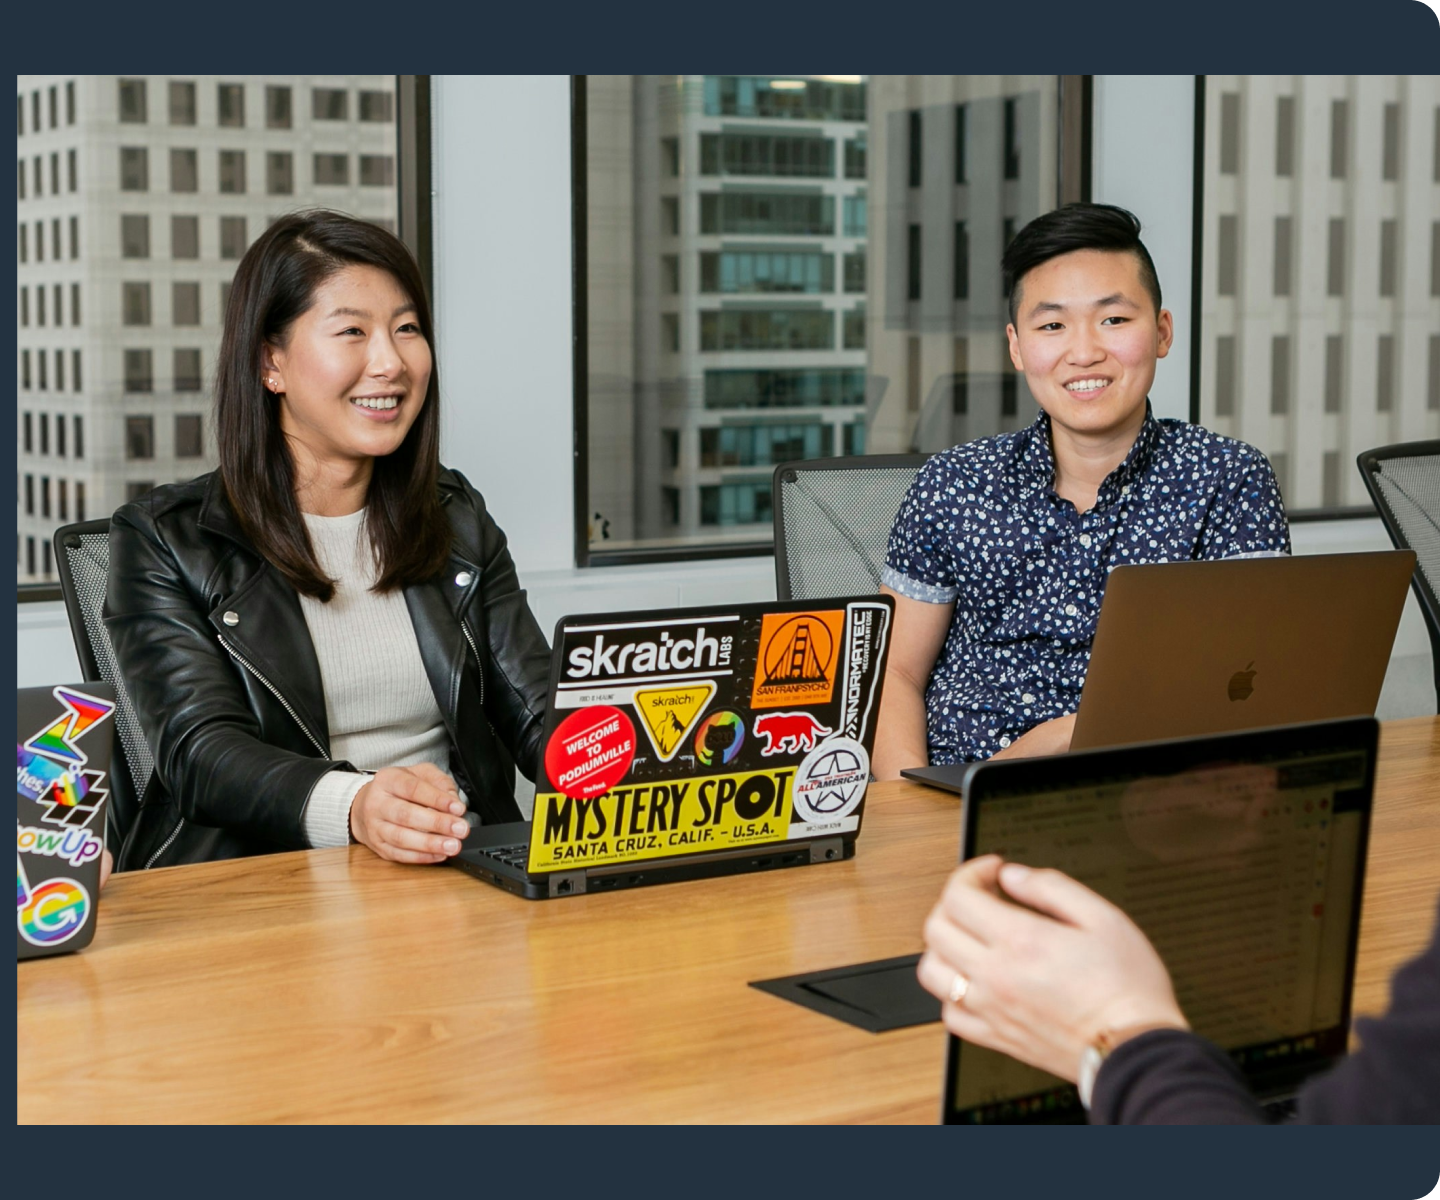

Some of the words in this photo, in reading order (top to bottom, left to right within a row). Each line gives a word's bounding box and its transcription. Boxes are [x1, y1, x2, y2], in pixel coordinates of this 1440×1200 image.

[567, 627, 719, 678] skratch
[718, 635, 733, 666] LABS
[847, 611, 866, 713] NORMATEC
[652, 694, 691, 707] skratch
[756, 687, 773, 696] SAN
[566, 720, 620, 755] WELCOME
[586, 743, 602, 758] TO
[558, 739, 631, 786] PODIUMVILLE
[797, 783, 816, 793] ALL
[816, 773, 866, 789] AMERICAN
[543, 783, 690, 845] MYSTERY
[692, 771, 794, 827] SPOT
[17, 831, 99, 862] owUp
[553, 842, 608, 860] SANTA
[615, 835, 662, 852] CRUZ,
[669, 828, 714, 846] CALIF.
[733, 822, 775, 838] U.S.A.
